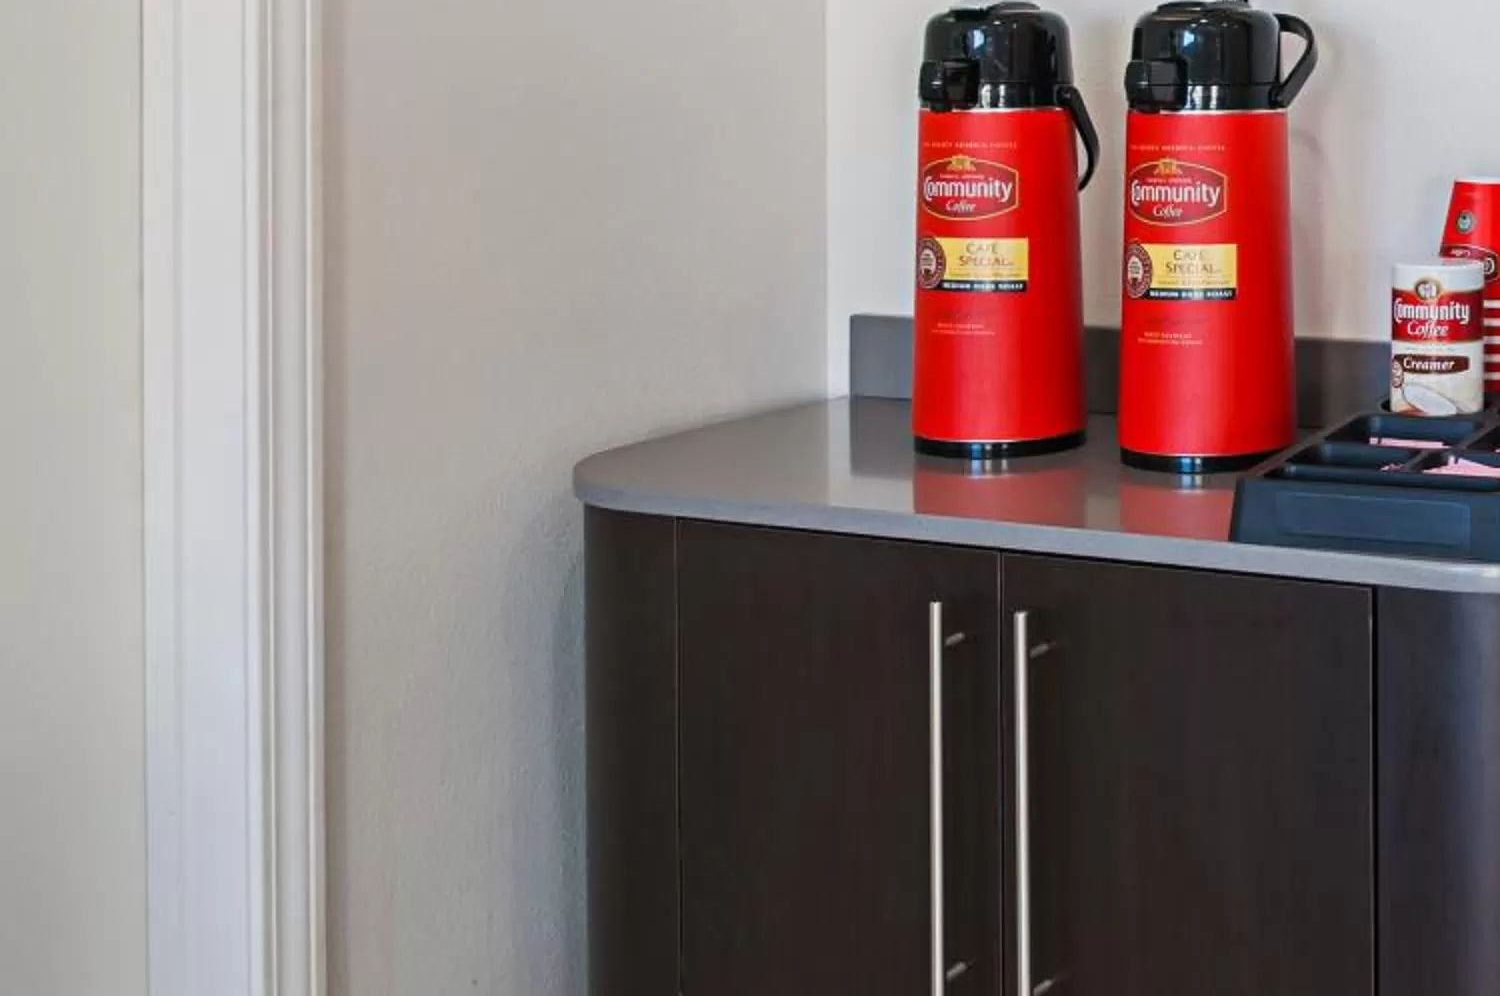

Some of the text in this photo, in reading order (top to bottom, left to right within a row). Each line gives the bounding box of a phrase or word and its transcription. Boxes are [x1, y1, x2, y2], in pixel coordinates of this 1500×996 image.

[924, 175, 1013, 202] Community
[1131, 180, 1221, 206] Community
[1152, 204, 1184, 218] Coffee
[1394, 297, 1470, 325] Community
[1407, 321, 1449, 340] Coffee
[1403, 356, 1455, 371] Creamer
